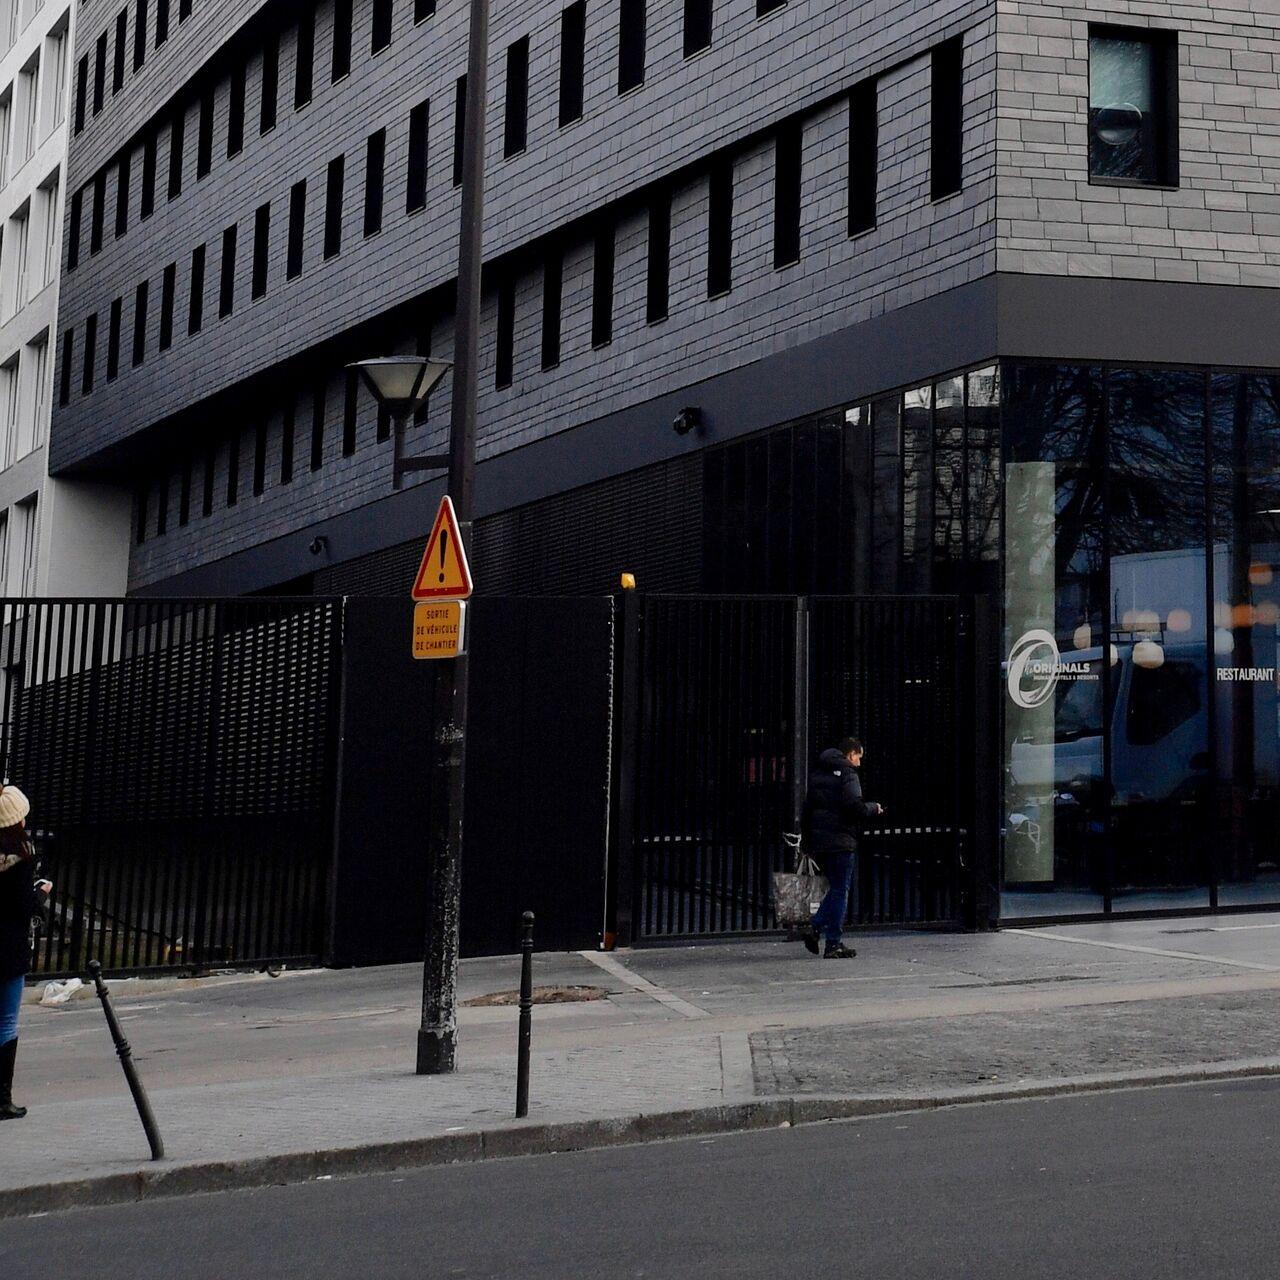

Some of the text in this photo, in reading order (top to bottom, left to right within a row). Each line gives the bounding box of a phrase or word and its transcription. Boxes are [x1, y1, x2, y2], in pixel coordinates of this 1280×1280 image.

[426, 609, 449, 619] SORTIE
[416, 624, 457, 635] DE VÉHICULE
[415, 640, 456, 650] DE CHANTIER
[1033, 663, 1090, 673] ORIGINALS
[1216, 668, 1275, 681] RESTAURANT
